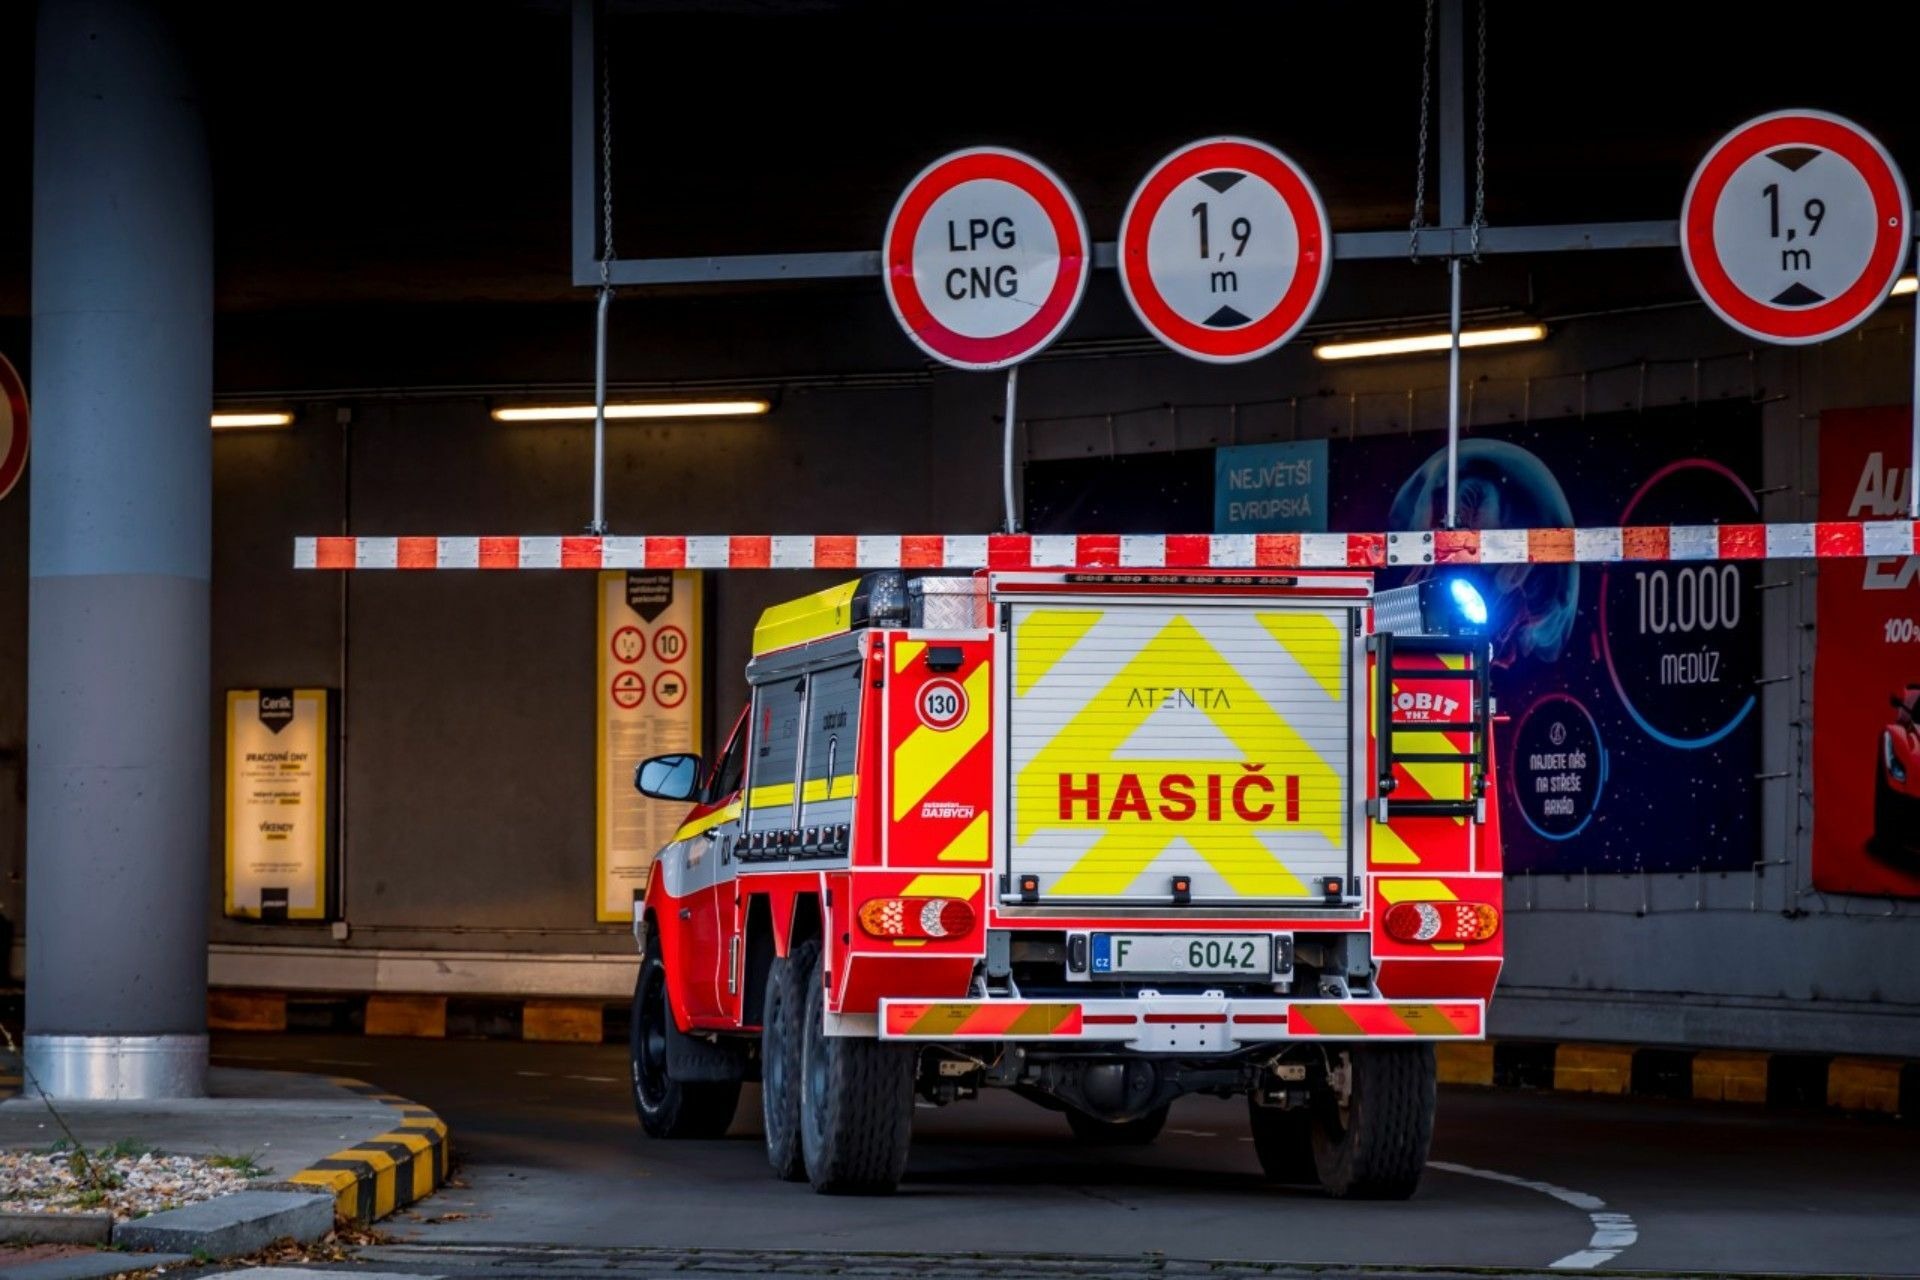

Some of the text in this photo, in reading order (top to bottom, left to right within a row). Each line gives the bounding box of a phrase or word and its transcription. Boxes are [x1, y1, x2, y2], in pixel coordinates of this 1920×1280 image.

[1762, 183, 1826, 242] 1,9
[948, 216, 1016, 252] LPG
[1191, 202, 1252, 262] 1,9
[1782, 248, 1811, 271] m
[945, 264, 1018, 300] CNG
[1211, 270, 1238, 293] m
[1229, 458, 1313, 490] NEJVĚTŠÍ
[1229, 493, 1311, 522] EVROPSKÁ
[1635, 564, 1740, 634] 10.000
[661, 635, 679, 654] 10
[1661, 645, 1720, 685] MEDÚZ
[928, 695, 956, 714] 130
[1127, 687, 1231, 709] ATENTA
[1530, 747, 1586, 770] NAJDETE NÁS
[1058, 763, 1300, 822] HASIČI
[1536, 776, 1549, 793] NA
[1095, 959, 1109, 967] CZ
[1116, 940, 1255, 968] F 6042
